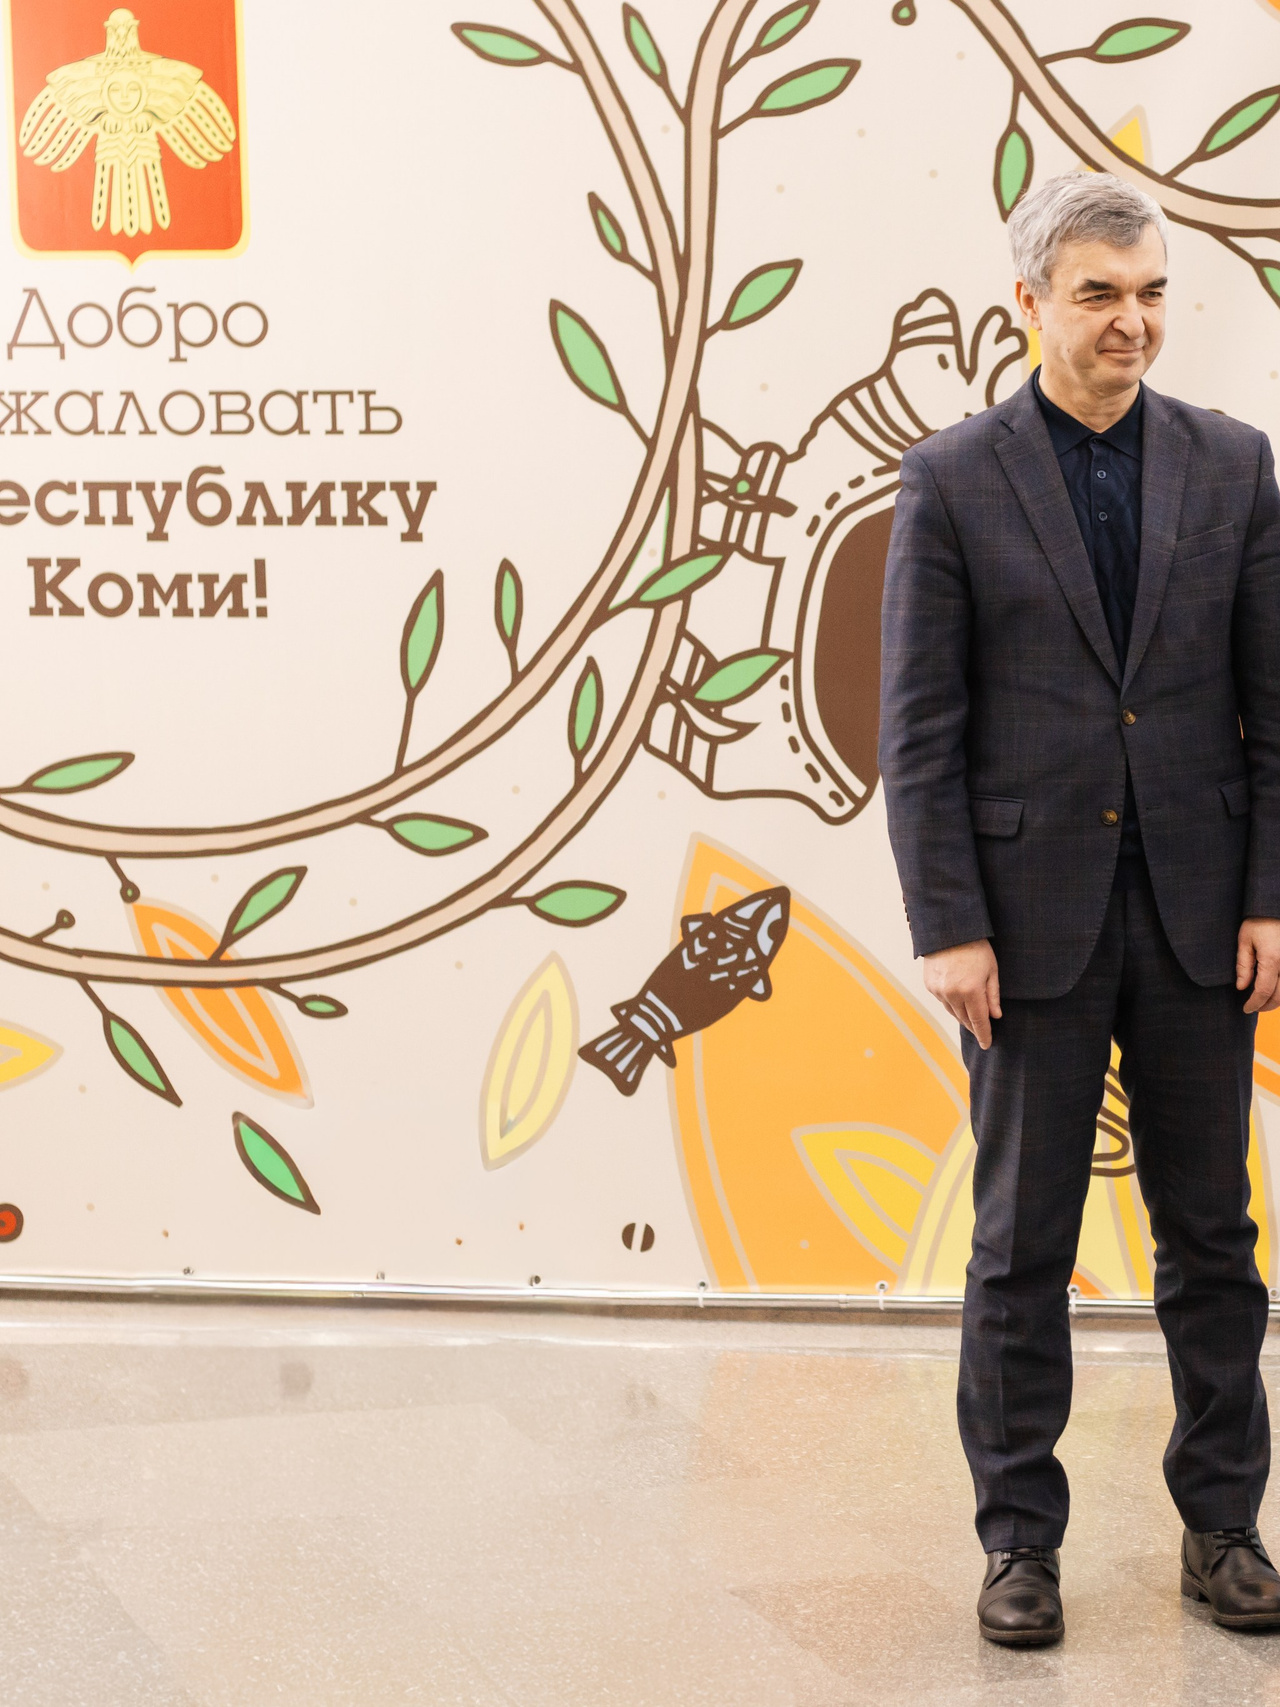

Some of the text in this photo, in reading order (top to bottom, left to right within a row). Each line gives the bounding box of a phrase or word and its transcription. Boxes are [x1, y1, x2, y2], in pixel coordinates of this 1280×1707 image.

[7, 286, 269, 363] Добро
[0, 389, 403, 437] жаловать
[0, 465, 437, 542] еспублику
[27, 557, 268, 618] Коми!
